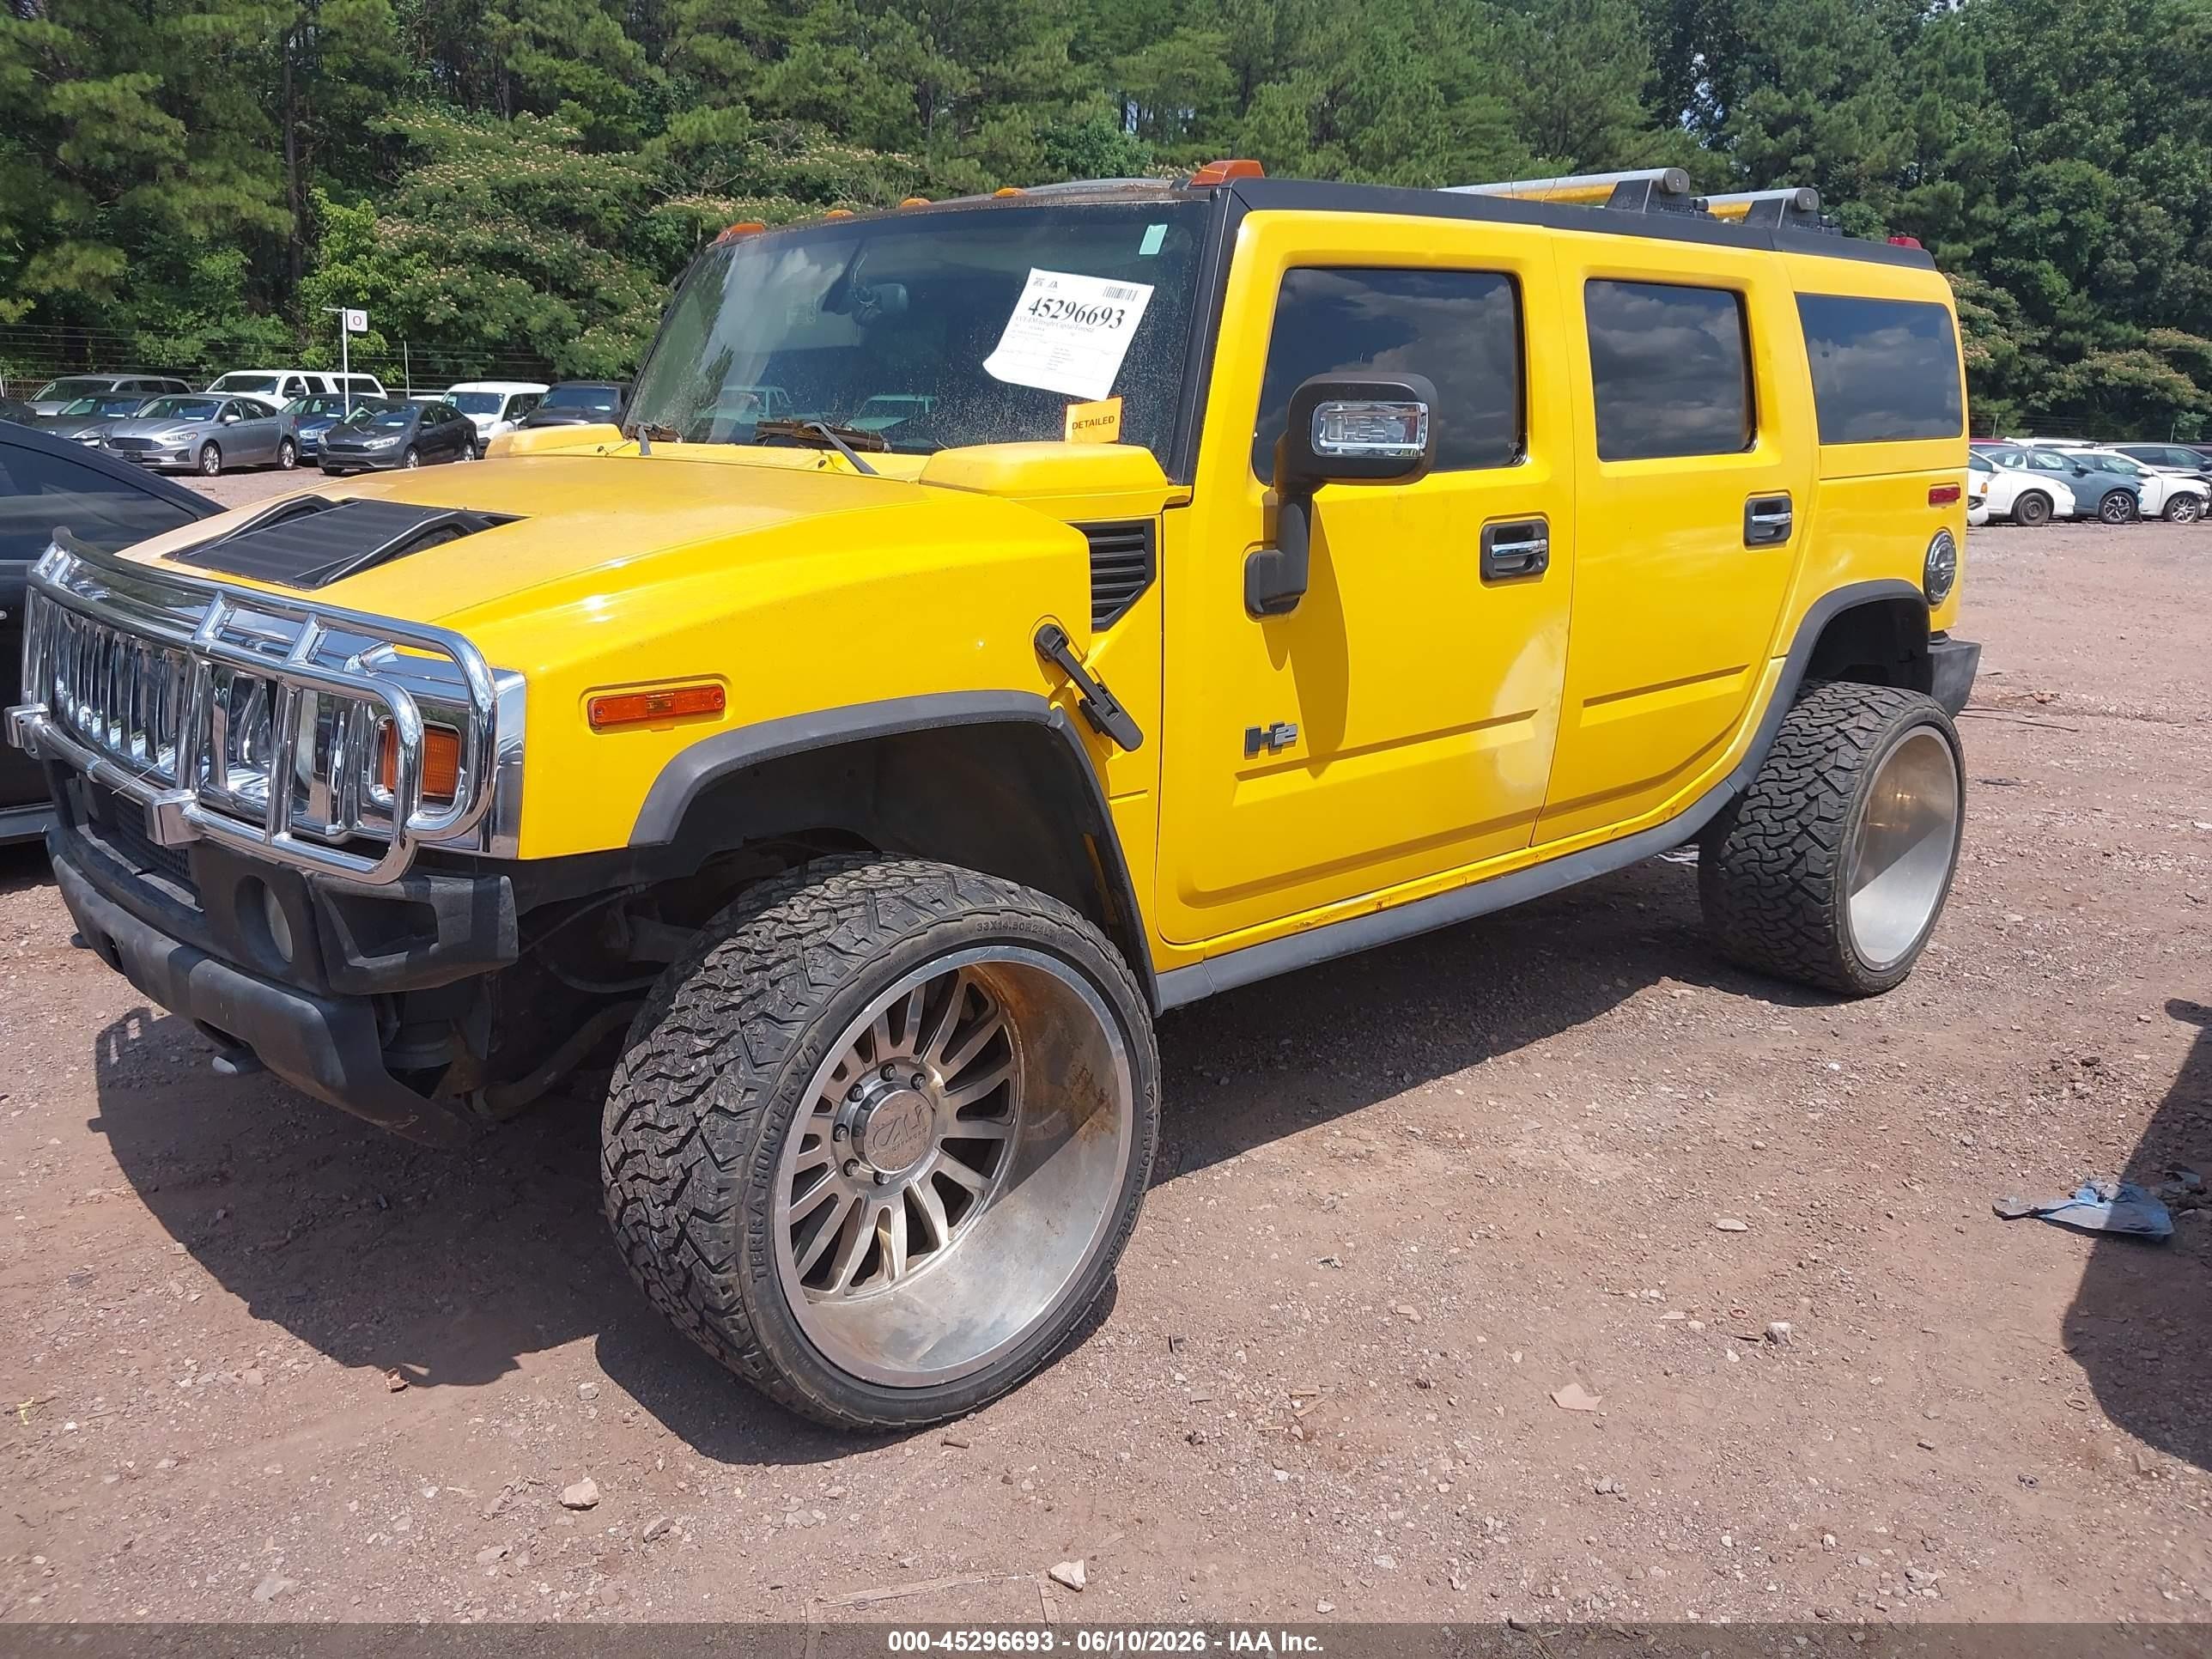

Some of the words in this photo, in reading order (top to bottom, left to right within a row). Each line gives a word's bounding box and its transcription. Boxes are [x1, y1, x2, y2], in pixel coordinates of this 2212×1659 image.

[1028, 296, 1126, 330] 45296693
[1072, 416, 1115, 430] DETAILED
[1245, 721, 1298, 754] H2
[753, 1085, 797, 1189] HUNTER
[749, 1201, 768, 1284] TERRA
